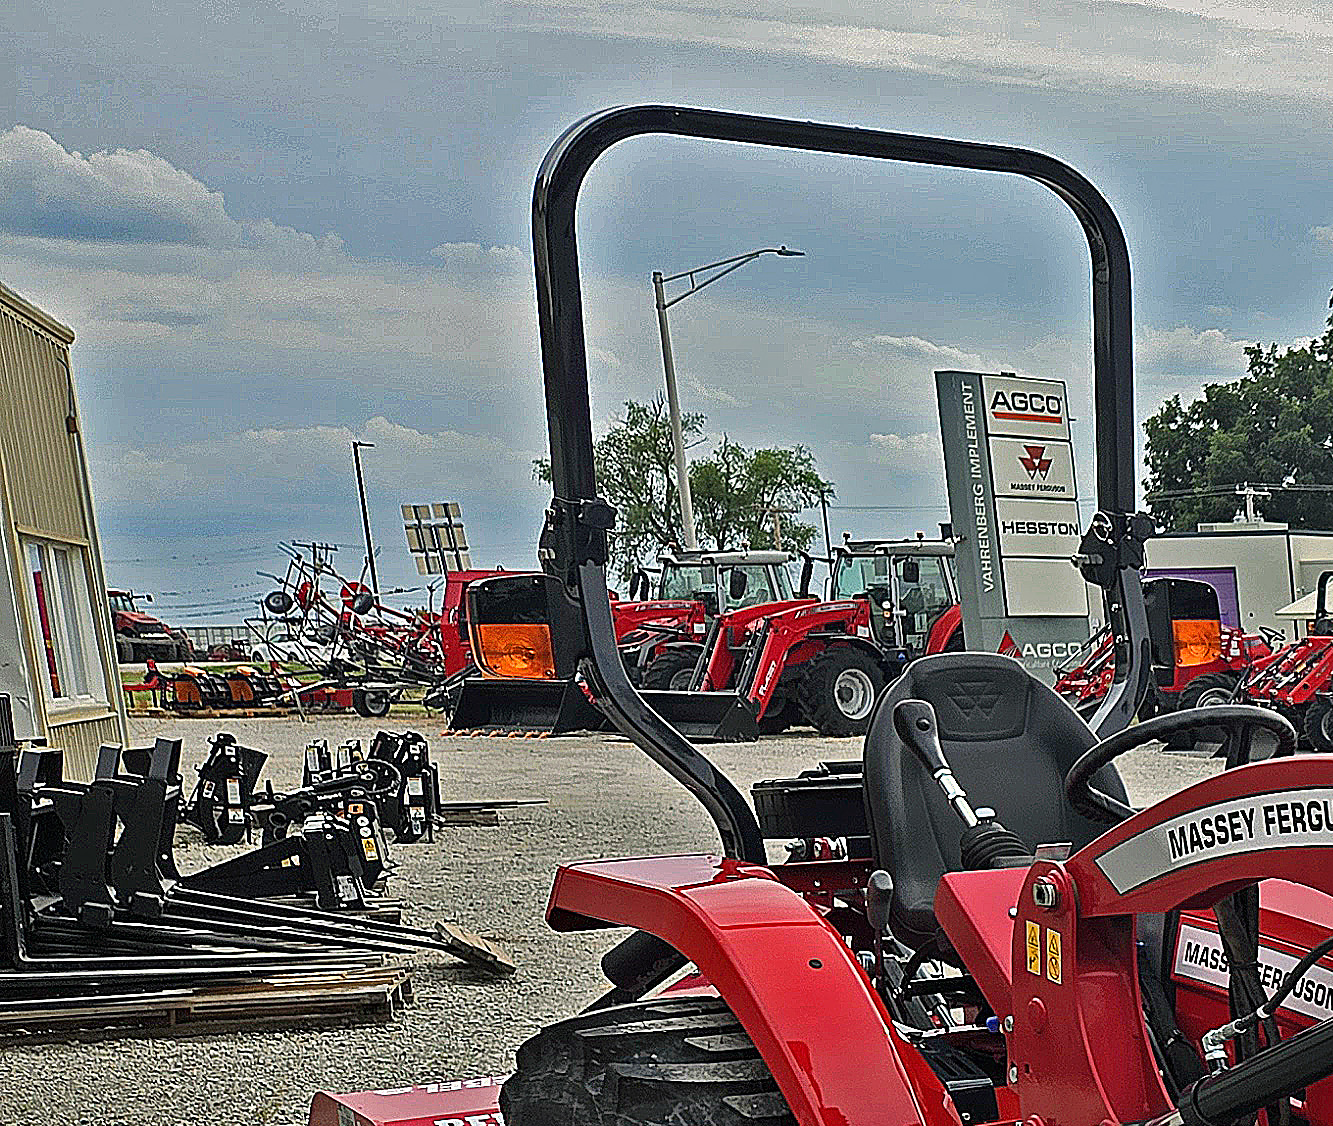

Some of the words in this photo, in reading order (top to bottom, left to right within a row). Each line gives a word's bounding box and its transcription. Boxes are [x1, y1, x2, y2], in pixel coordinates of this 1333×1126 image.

[991, 391, 1062, 415] AGCO
[961, 381, 982, 478] IMPLEMENT
[972, 483, 994, 593] VAHRENBERG
[1002, 521, 1079, 535] HESSTON
[1168, 807, 1255, 860] MASSEY
[1184, 941, 1230, 974] MASS
